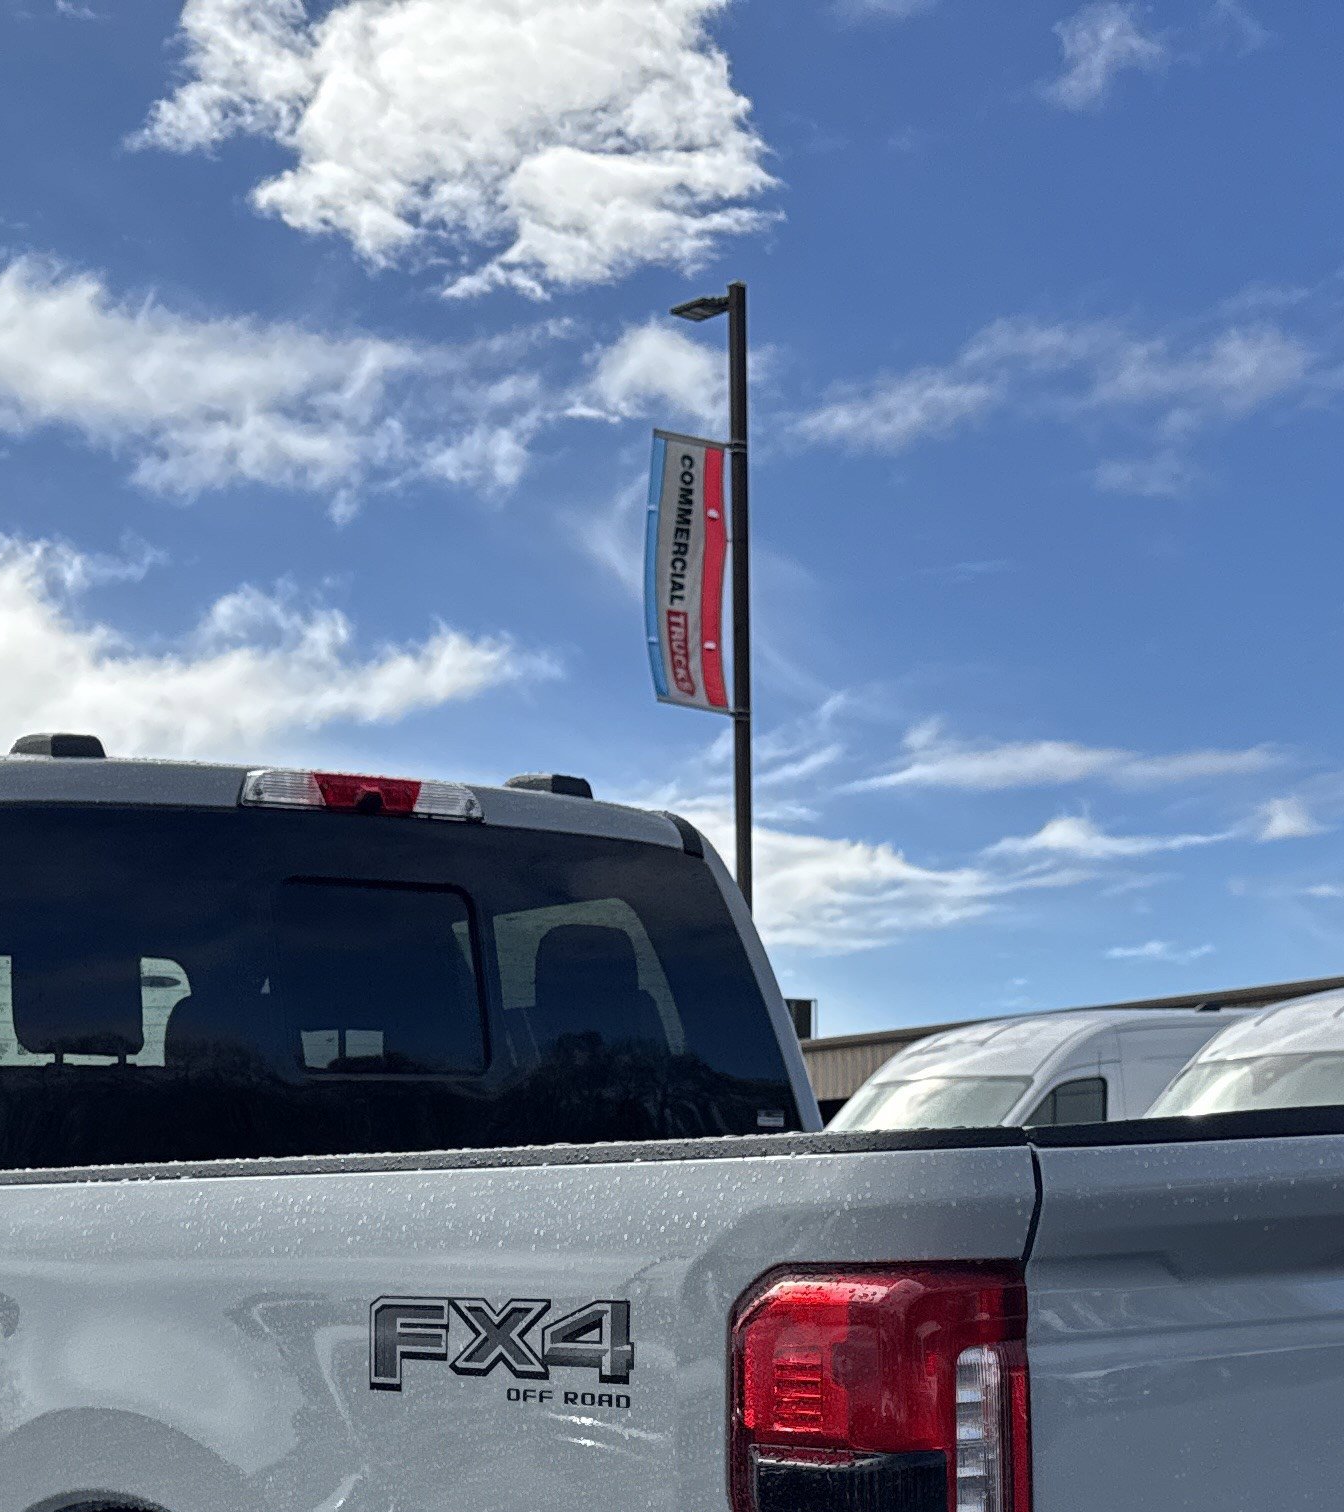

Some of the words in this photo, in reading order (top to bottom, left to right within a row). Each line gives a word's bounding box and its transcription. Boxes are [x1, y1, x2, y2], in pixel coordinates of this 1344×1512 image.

[668, 453, 695, 606] COMMERCIAL
[668, 613, 693, 694] TRUCKS
[369, 1295, 635, 1392] FX4
[506, 1387, 554, 1404] OFF
[563, 1390, 632, 1409] ROAD
